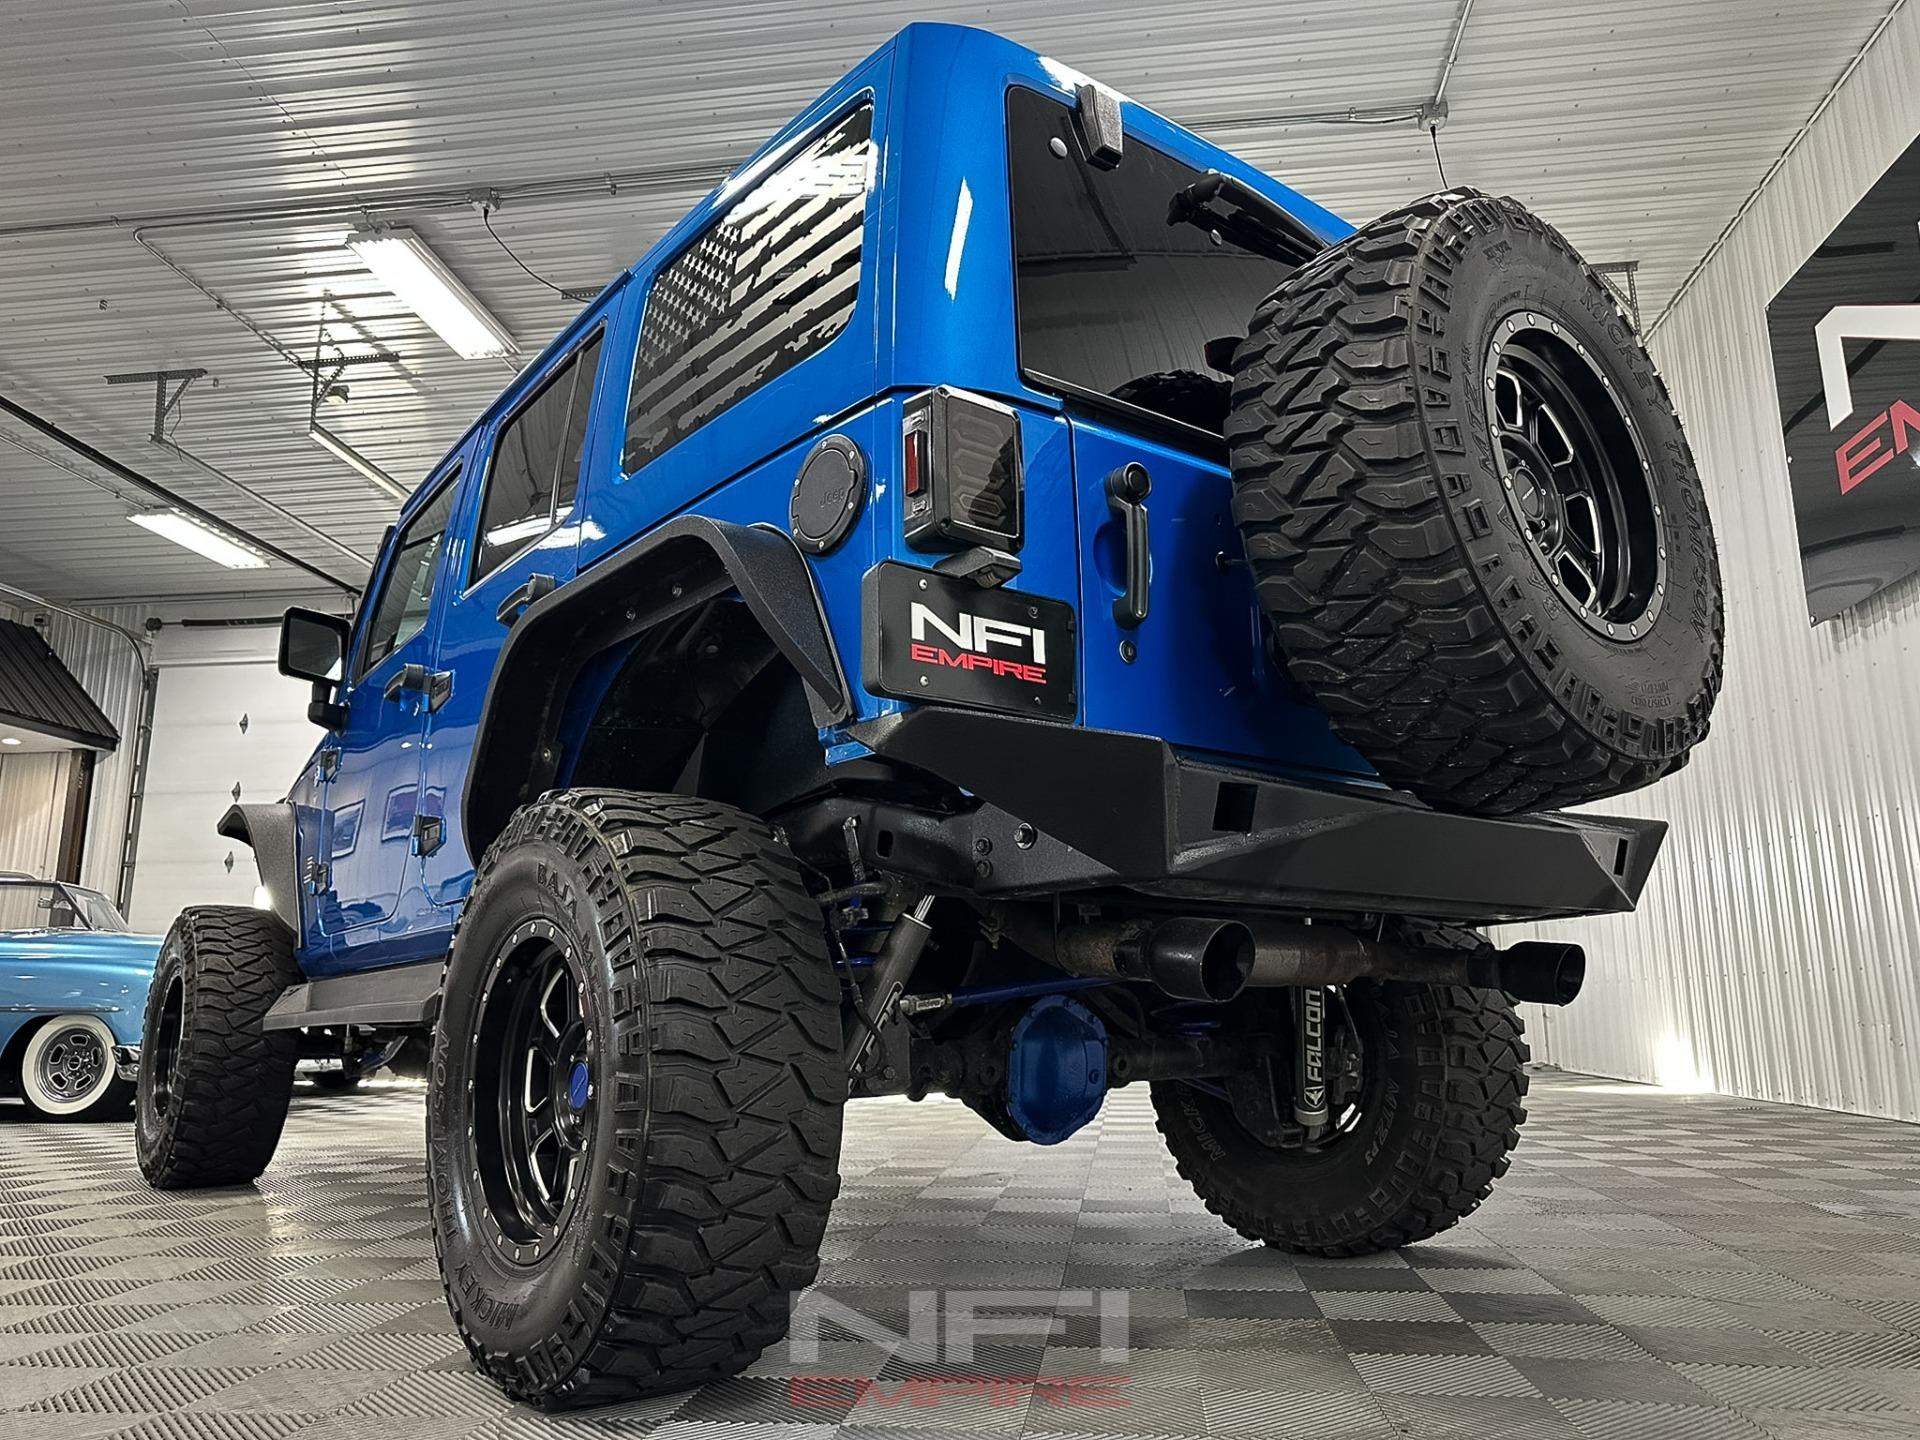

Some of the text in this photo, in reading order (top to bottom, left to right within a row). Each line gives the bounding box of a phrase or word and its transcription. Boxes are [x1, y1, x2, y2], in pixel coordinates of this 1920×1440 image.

[1581, 286, 1708, 642] MICKEY THOMPSON
[911, 601, 1046, 665] NFI
[911, 643, 1047, 684] EMPIRE
[537, 862, 578, 925] BAJA
[1304, 988, 1322, 1082] FALCON
[1176, 1082, 1227, 1161] MICKE
[431, 1029, 520, 1331] MICKEY THOMPSON
